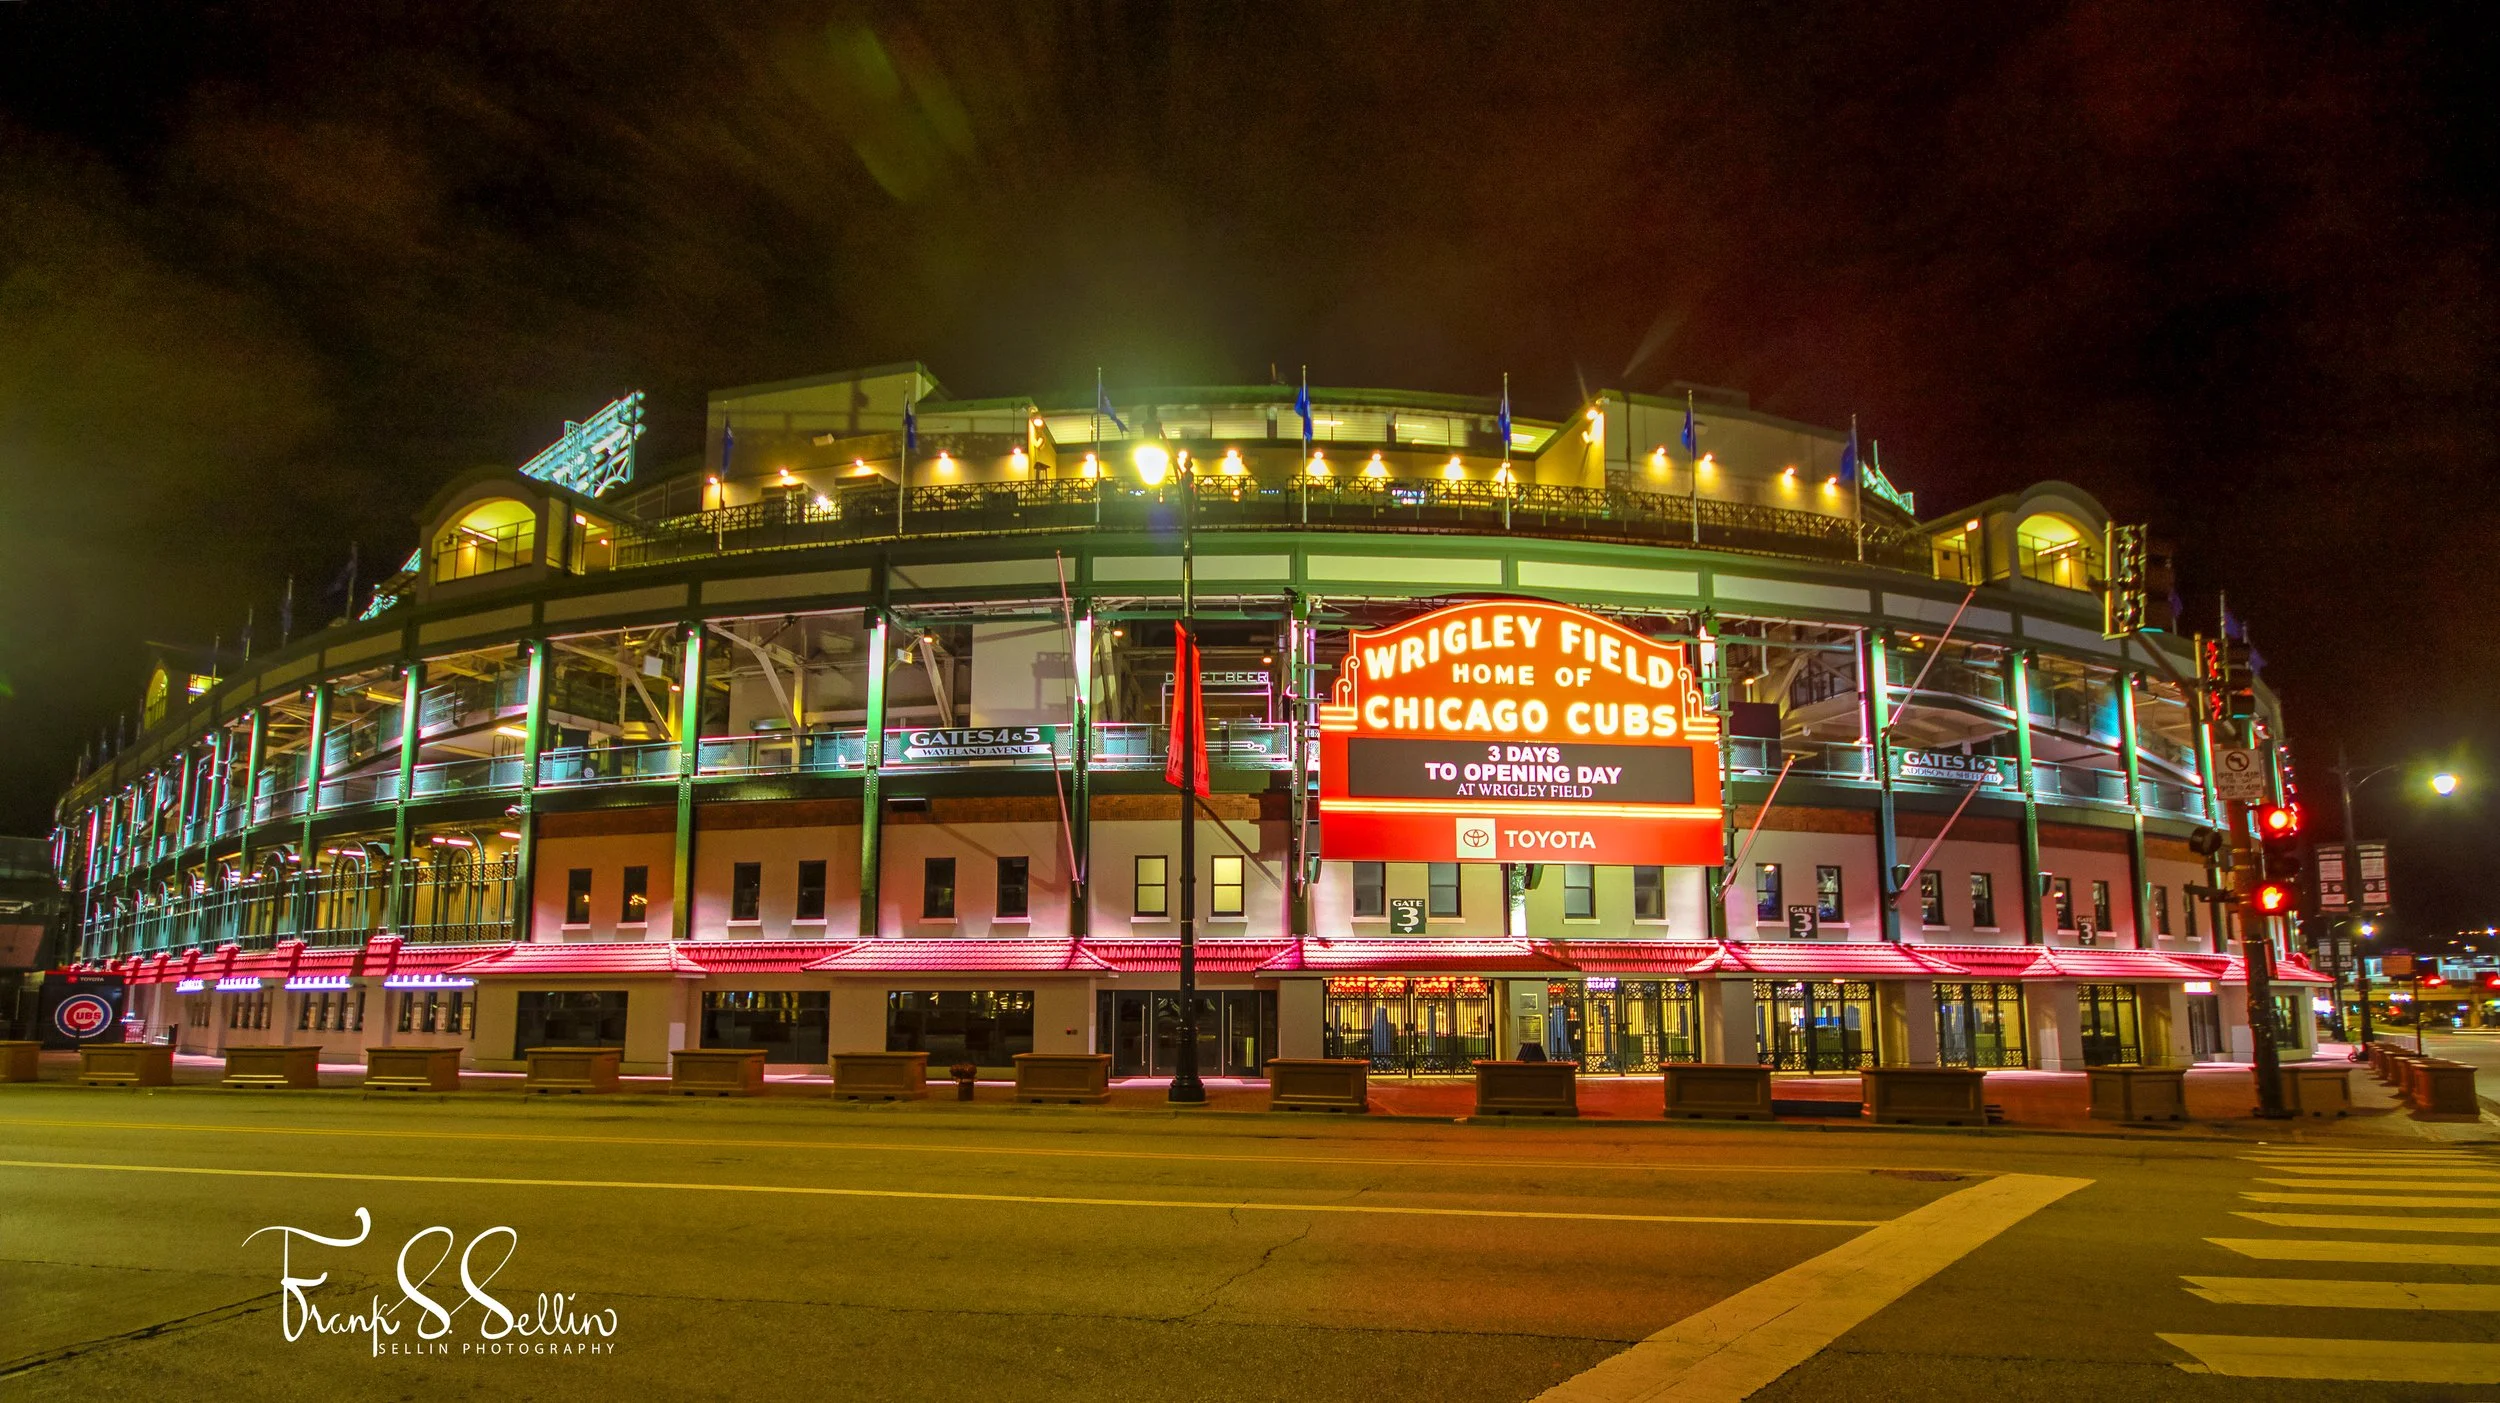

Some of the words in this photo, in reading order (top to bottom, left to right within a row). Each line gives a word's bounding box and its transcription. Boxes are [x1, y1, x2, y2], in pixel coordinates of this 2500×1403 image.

[1364, 614, 1543, 681] WRIGLEY
[1559, 620, 1675, 689] FIELD
[1165, 672, 1217, 683] DFT
[1225, 672, 1269, 683] BEER
[1452, 663, 1535, 686] HOME
[1555, 666, 1592, 688] OF
[1364, 696, 1550, 733] CHICAGO
[1566, 702, 1678, 737] CUBS
[909, 730, 994, 747] GATES
[922, 747, 988, 757] WAVELAND
[990, 745, 1034, 754] AVENUE
[1487, 745, 1501, 762] 3
[1507, 746, 1560, 764] DAYS
[1903, 751, 1965, 769] GATES
[1425, 762, 1458, 781] TO
[1463, 763, 1570, 784] OPENING
[1577, 766, 1622, 785] DAY
[1456, 783, 1476, 796] AT
[1479, 784, 1548, 798] WRIGLEY
[1550, 785, 1593, 799] FIELD
[1504, 829, 1596, 849] TOYOTA
[1396, 906, 1420, 927] 3
[1794, 913, 1813, 932] 3
[2080, 922, 2093, 940] 3
